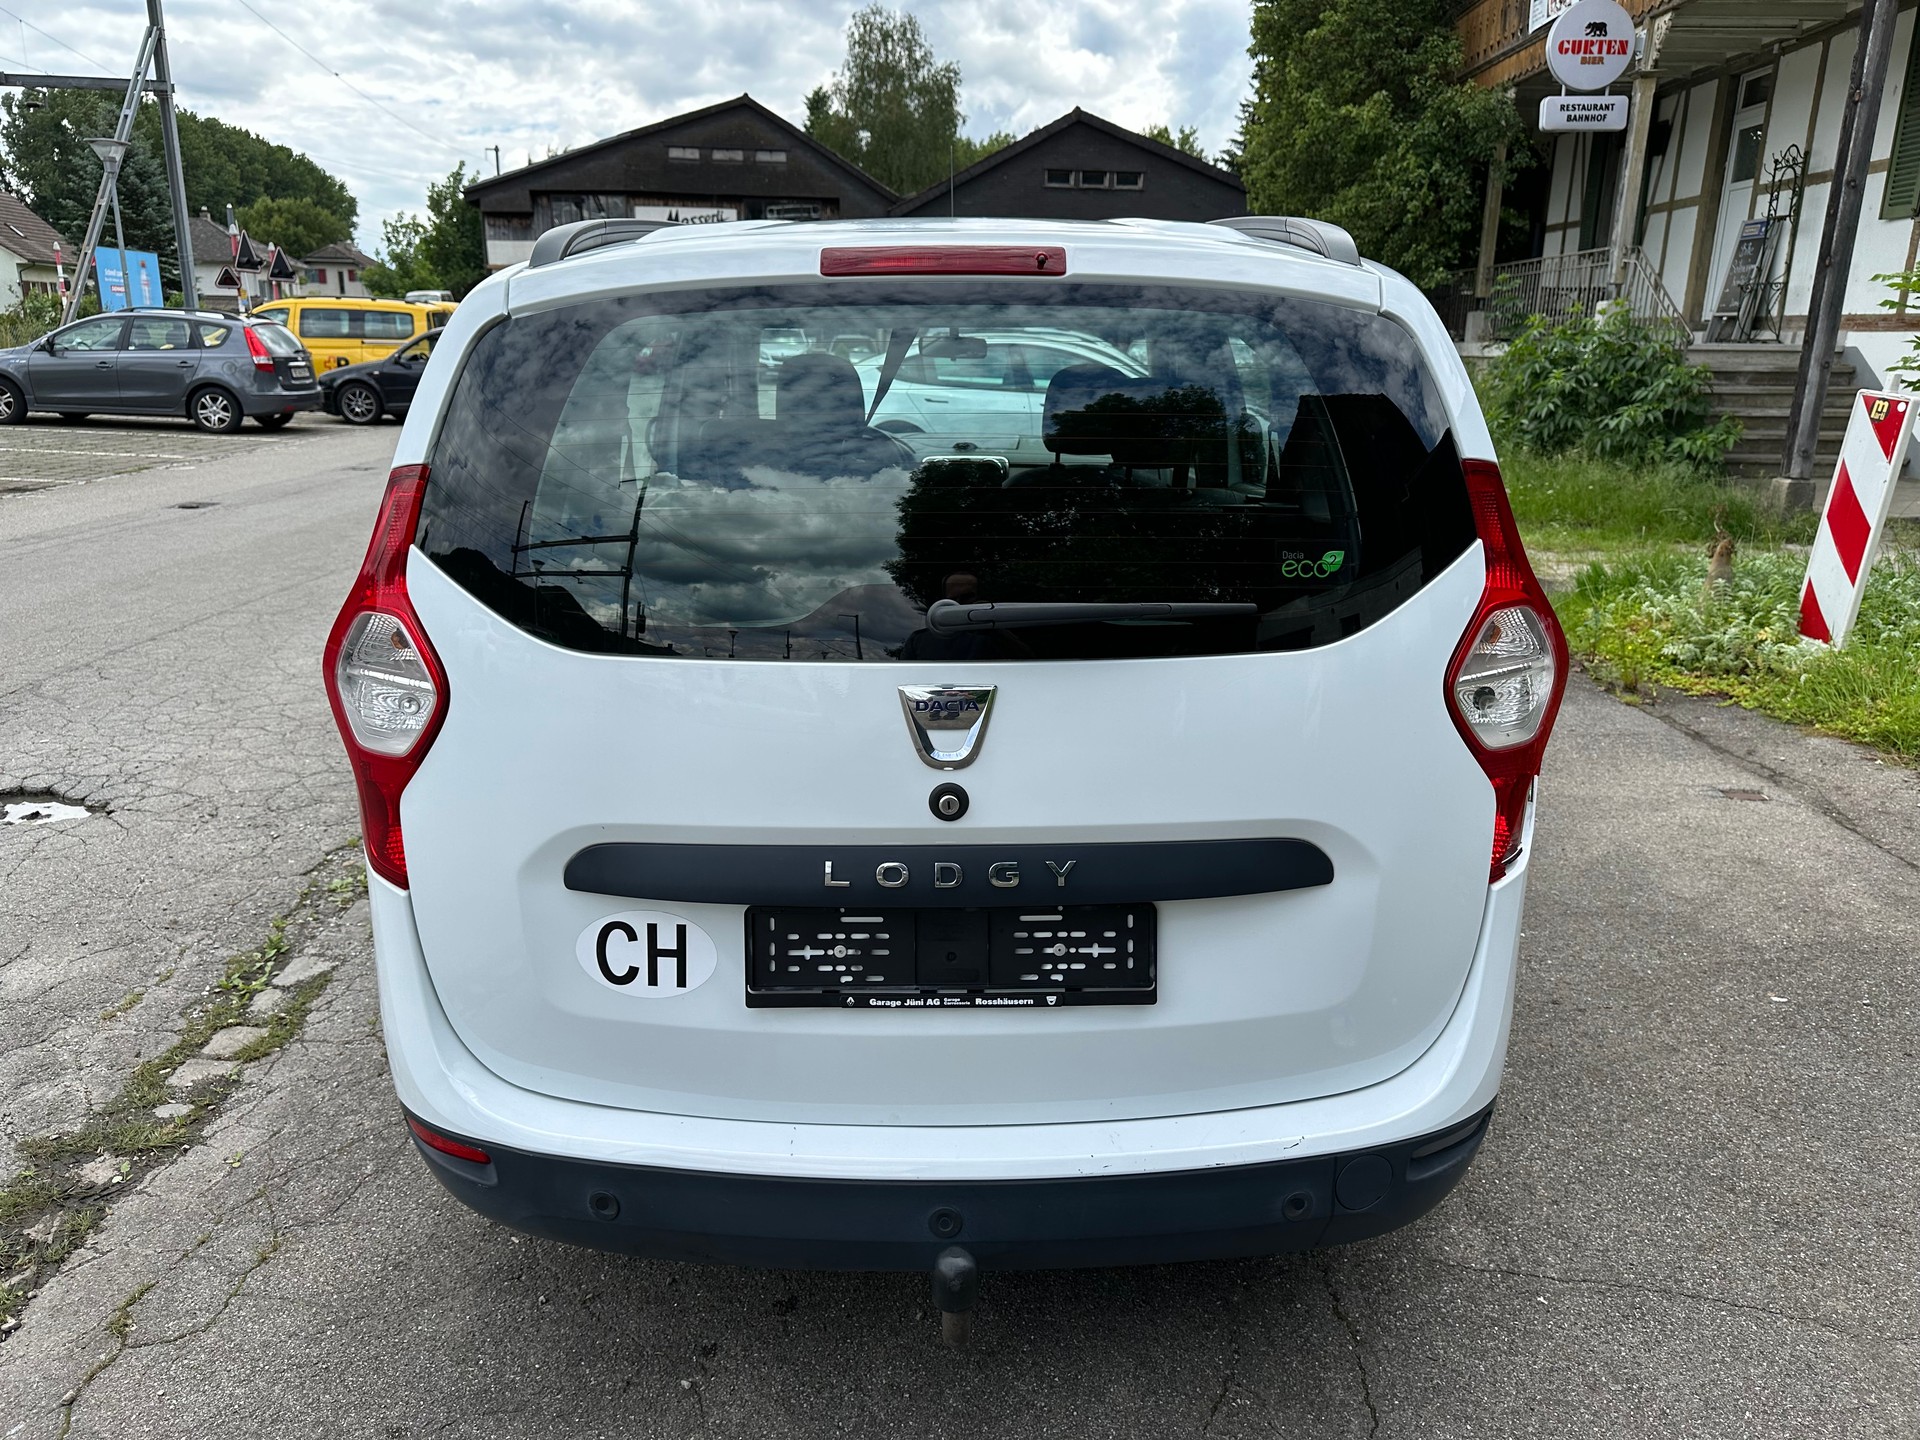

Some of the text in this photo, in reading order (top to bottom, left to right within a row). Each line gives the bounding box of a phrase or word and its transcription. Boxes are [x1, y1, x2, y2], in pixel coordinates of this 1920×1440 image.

[1558, 40, 1629, 55] GURTEN
[1580, 56, 1605, 65] BIER
[1560, 103, 1615, 112] RESTAURANT
[1566, 114, 1607, 122] BAHNHOF
[1282, 551, 1304, 559] Dacia
[915, 700, 980, 712] DACIA
[824, 860, 1077, 888] LODGY
[596, 921, 687, 988] CH
[869, 999, 902, 1007] Garage
[975, 998, 1034, 1006] Rosshäusern
